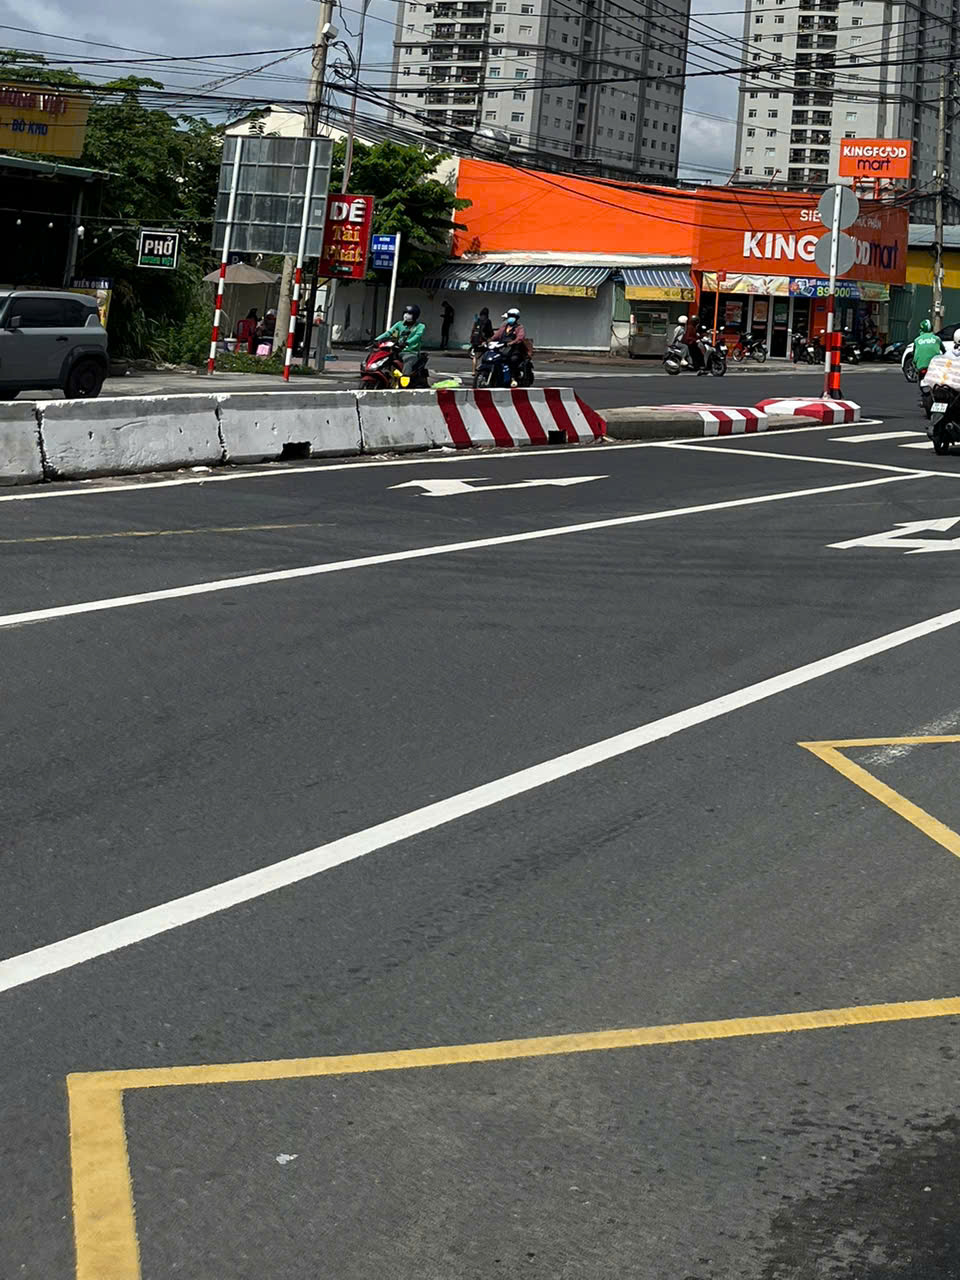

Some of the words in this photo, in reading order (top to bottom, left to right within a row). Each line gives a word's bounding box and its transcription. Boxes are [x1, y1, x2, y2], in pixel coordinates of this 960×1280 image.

[843, 145, 907, 158] KINGFOOD
[857, 158, 891, 171] mart
[329, 198, 366, 222] DÊ
[144, 236, 174, 255] PHỞ
[918, 337, 937, 345] Grab
